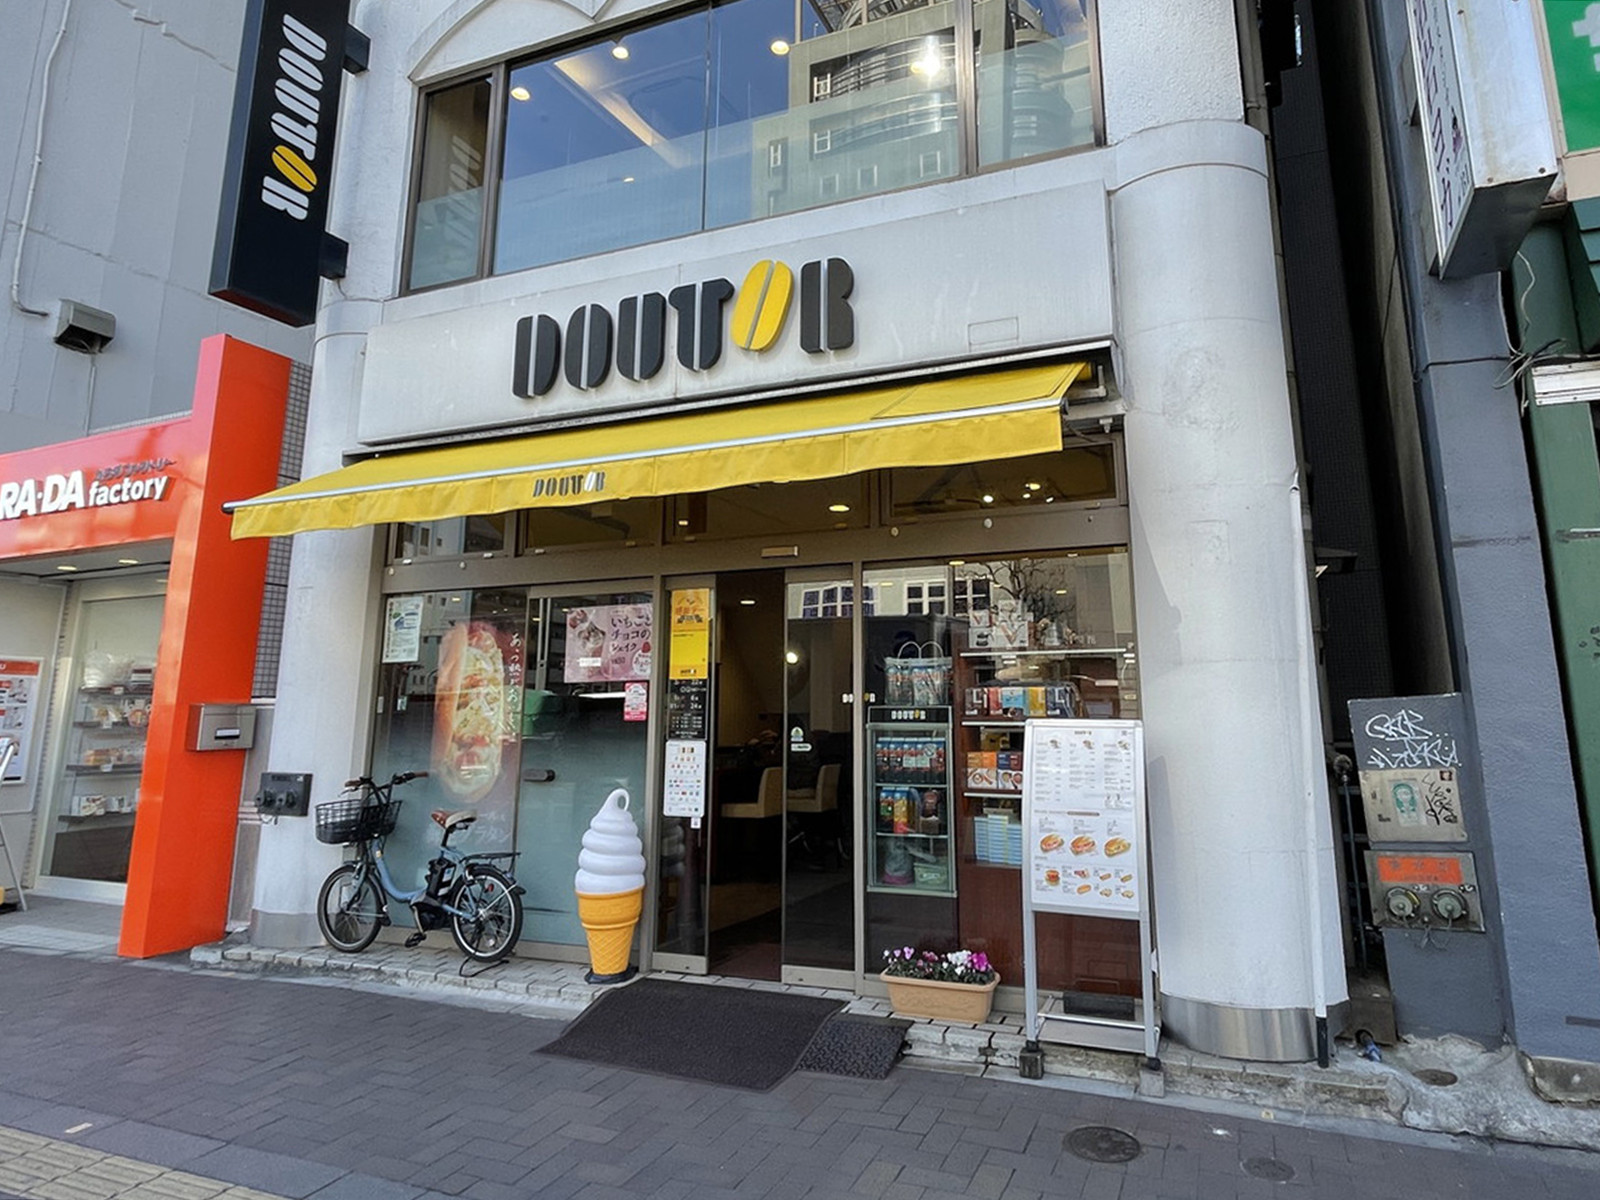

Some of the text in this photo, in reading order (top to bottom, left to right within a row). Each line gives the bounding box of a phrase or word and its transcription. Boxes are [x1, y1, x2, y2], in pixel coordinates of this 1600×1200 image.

[262, 13, 327, 220] DOUTOR
[512, 257, 855, 399] DOUTOR
[89, 475, 168, 507] factory
[532, 471, 606, 497] DOUTOR
